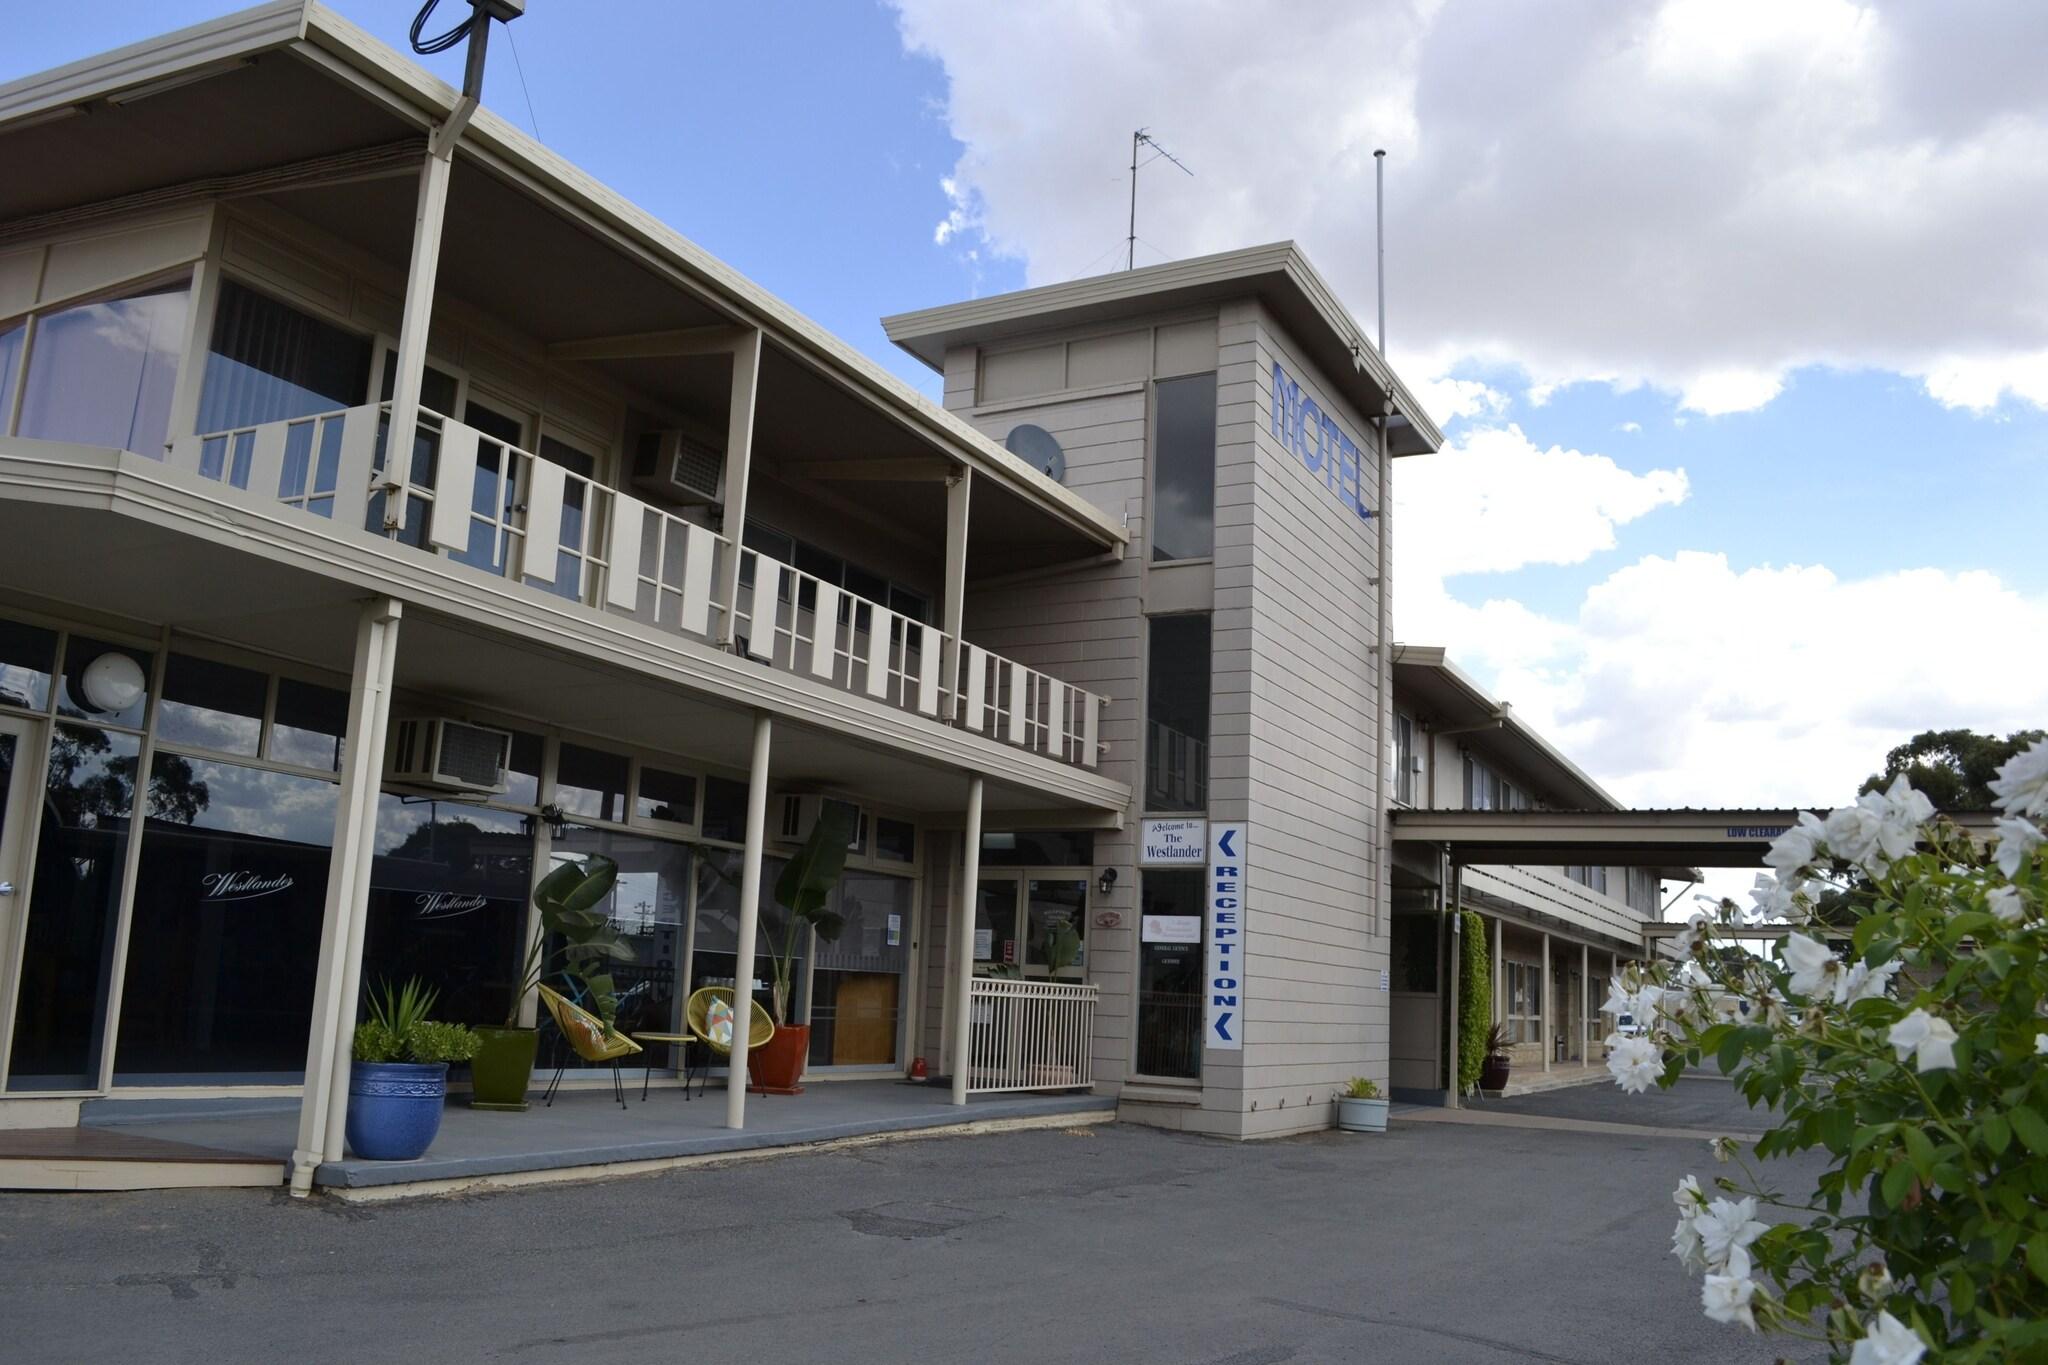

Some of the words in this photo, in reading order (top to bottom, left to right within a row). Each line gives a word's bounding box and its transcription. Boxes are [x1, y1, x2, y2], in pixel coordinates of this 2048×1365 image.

[1272, 360, 1372, 519] MOTEL
[1152, 823, 1184, 832] Welcome
[1728, 826, 1746, 838] LOW
[1164, 833, 1183, 843] The
[1147, 845, 1202, 858] Westlander
[202, 870, 294, 899] Westlander
[416, 891, 487, 917] Westlander
[1213, 866, 1239, 1007] RECEPTION
